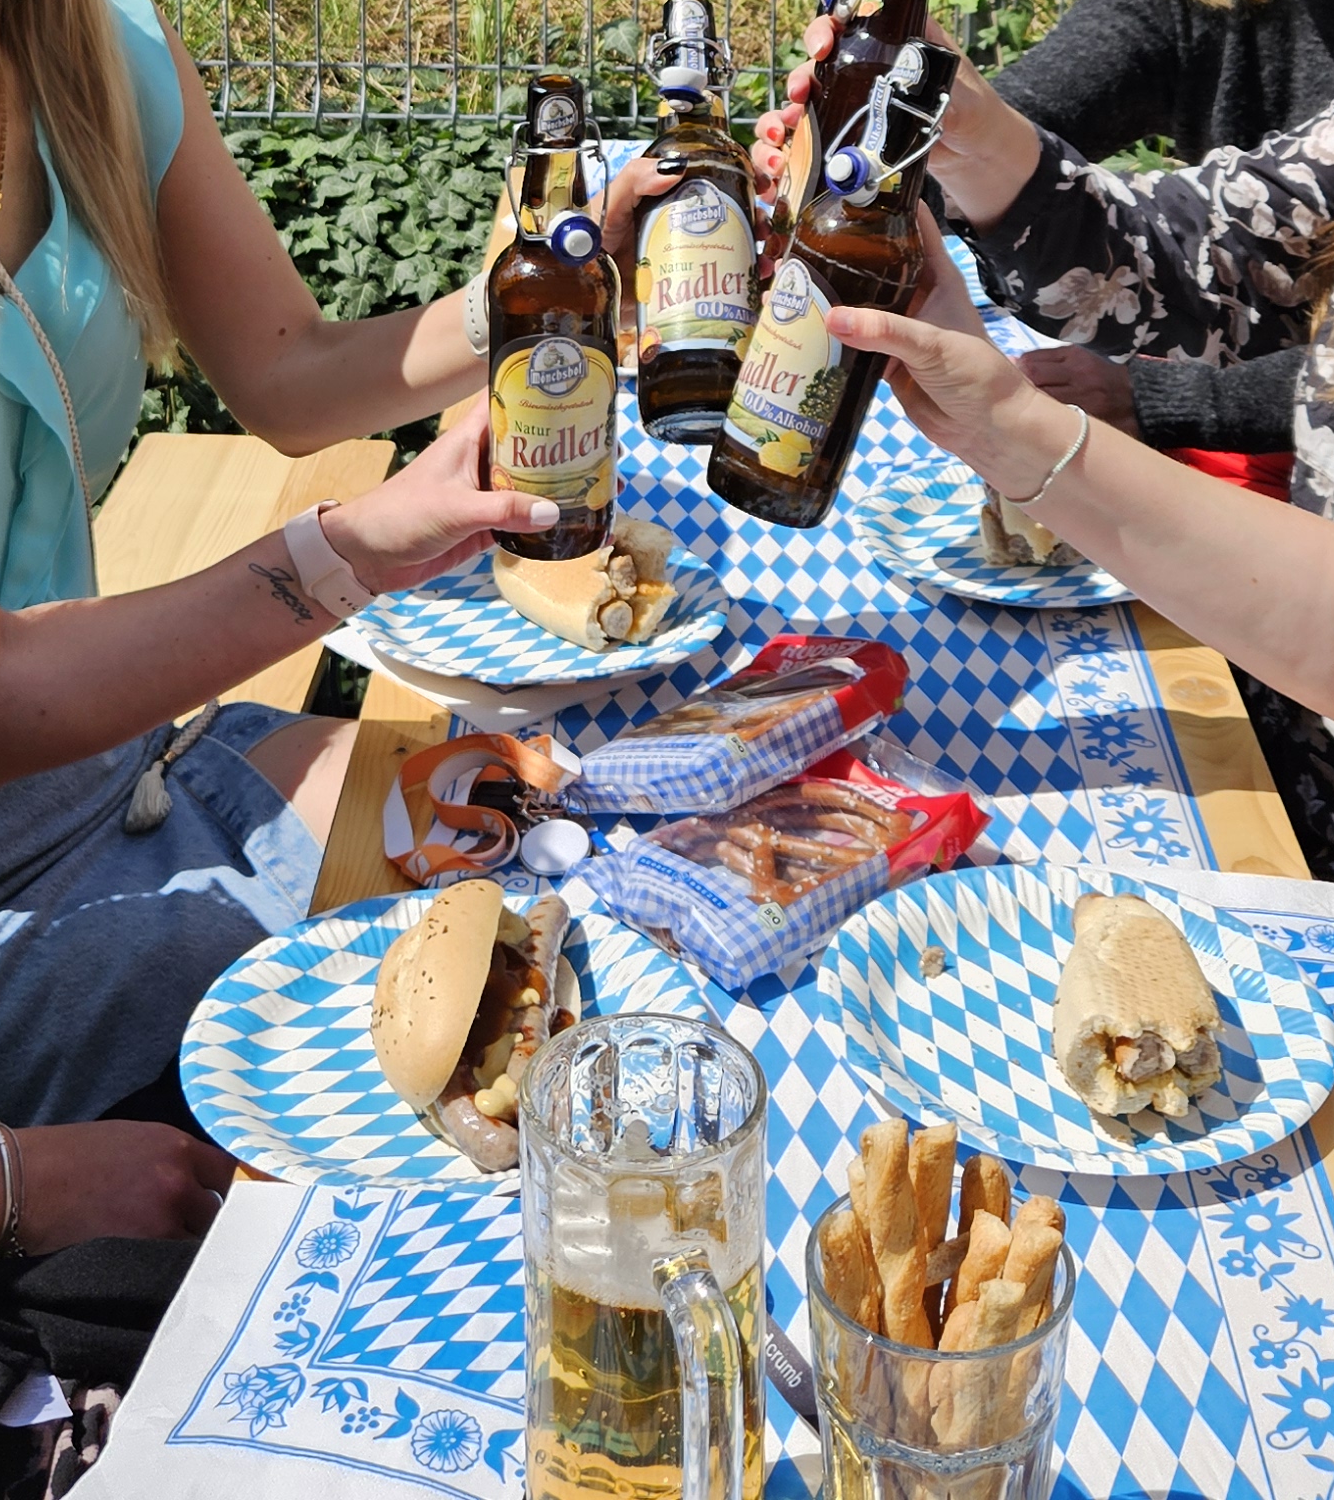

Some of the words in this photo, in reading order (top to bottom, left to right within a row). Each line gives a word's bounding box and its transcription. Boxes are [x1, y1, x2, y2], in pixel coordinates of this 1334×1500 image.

[659, 260, 694, 276] Natur
[656, 260, 745, 313] Radler
[738, 351, 806, 396] adler
[514, 420, 551, 437] Natur
[774, 410, 823, 438] Alkohol
[511, 423, 604, 468] Radler
